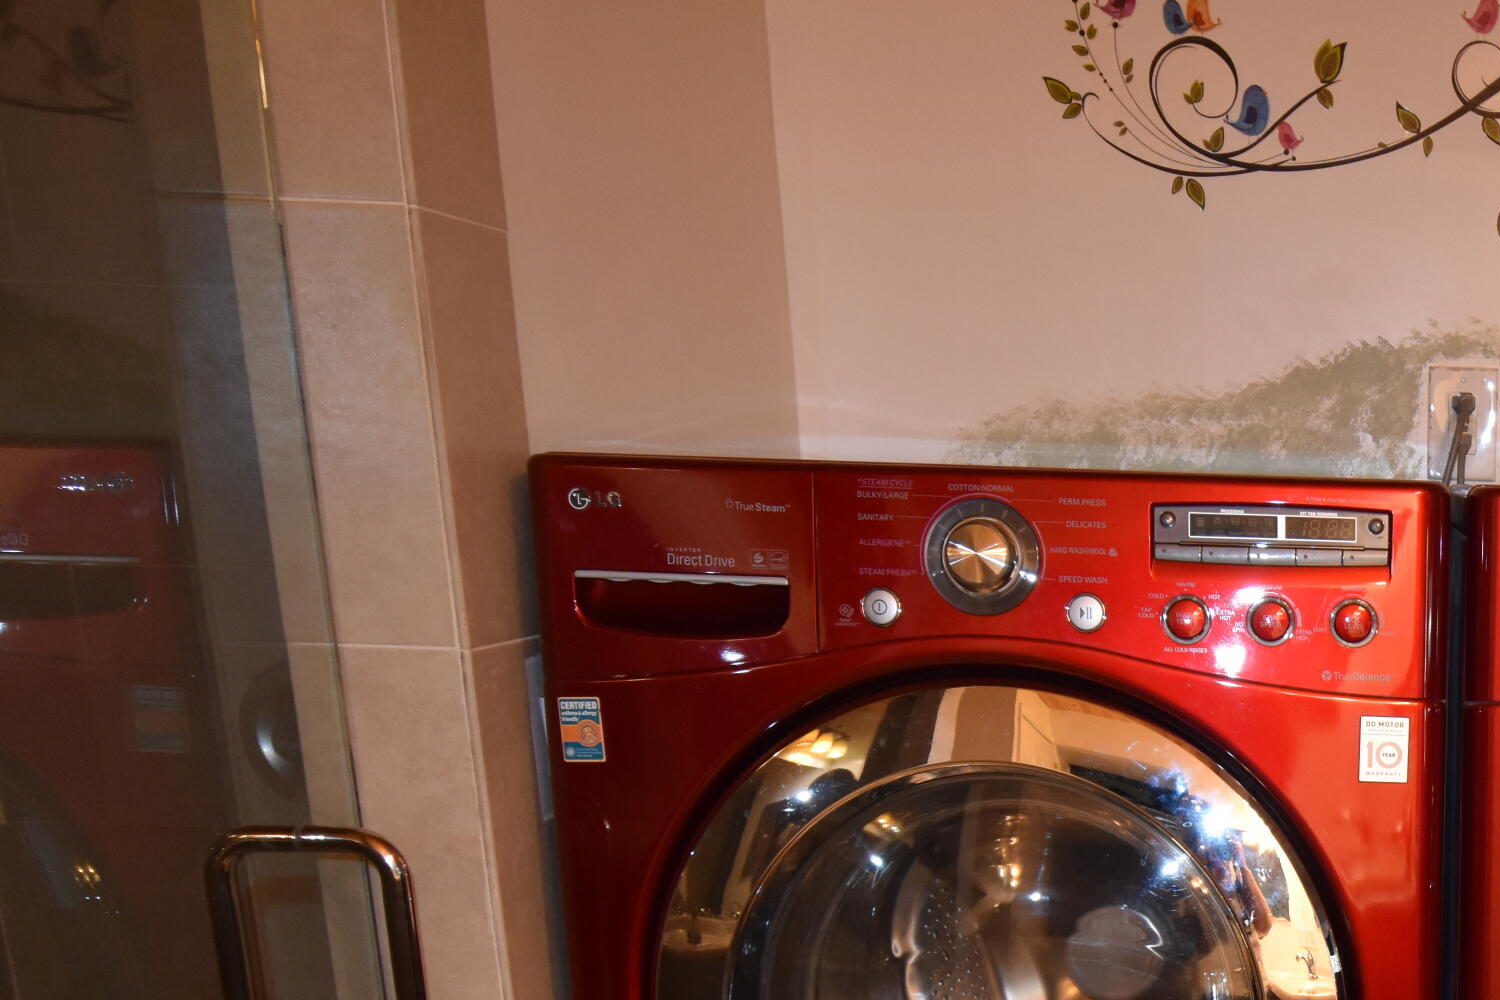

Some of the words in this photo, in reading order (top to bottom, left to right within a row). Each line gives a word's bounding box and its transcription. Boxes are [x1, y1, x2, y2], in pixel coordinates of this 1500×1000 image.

[857, 513, 894, 521] SANITARY
[1065, 520, 1107, 529] DELICATES
[667, 553, 702, 567] Direct
[704, 554, 736, 568] Drive
[859, 568, 886, 577] STEAM
[1058, 575, 1083, 584] SPEED
[1084, 576, 1108, 585] WASH
[560, 701, 597, 709] CERTIFIED
[1379, 721, 1405, 729] MOTOR
[1366, 741, 1403, 770] 10
